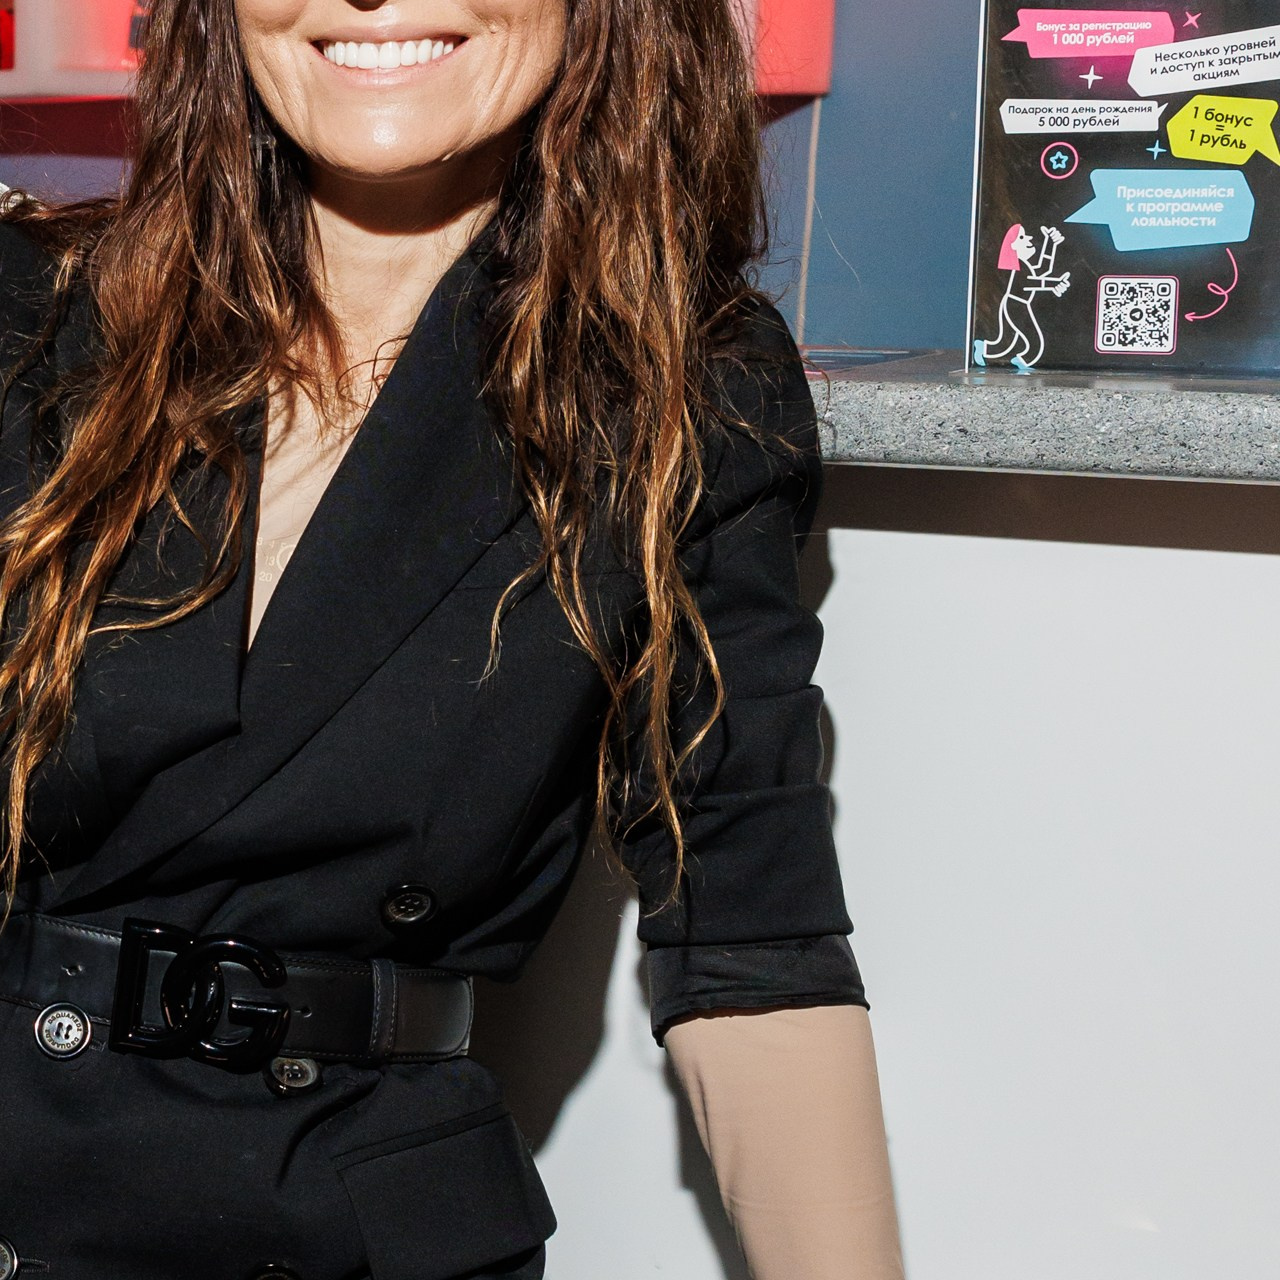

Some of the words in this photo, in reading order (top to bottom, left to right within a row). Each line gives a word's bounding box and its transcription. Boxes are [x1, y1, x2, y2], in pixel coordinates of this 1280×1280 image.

[1036, 22, 1067, 33] Бонус
[1068, 22, 1080, 31] за
[1081, 21, 1153, 32] регистрацию
[1052, 33, 1058, 45] 1
[1061, 33, 1084, 45] 000
[1086, 32, 1135, 46] рублей
[1154, 46, 1220, 62] Несколько
[1223, 36, 1276, 55] уровней
[1150, 67, 1157, 75] и
[1160, 60, 1205, 75] доступ
[1208, 59, 1215, 67] к
[1193, 69, 1240, 81] акциям
[1008, 105, 1053, 115] Подарок
[1056, 106, 1069, 114] на
[1071, 105, 1096, 114] день
[1098, 105, 1153, 115] рождения
[1193, 106, 1199, 119] 1
[1204, 107, 1254, 128] бонус
[1038, 116, 1045, 127] 5
[1048, 116, 1070, 127] 000
[1072, 115, 1120, 129] рублей
[1189, 129, 1195, 142] 1
[1199, 133, 1247, 150] рубль
[1116, 184, 1235, 200] Присоединяйся
[1125, 203, 1134, 213] к
[1137, 202, 1224, 214] программе
[1131, 217, 1217, 227] лояльности
